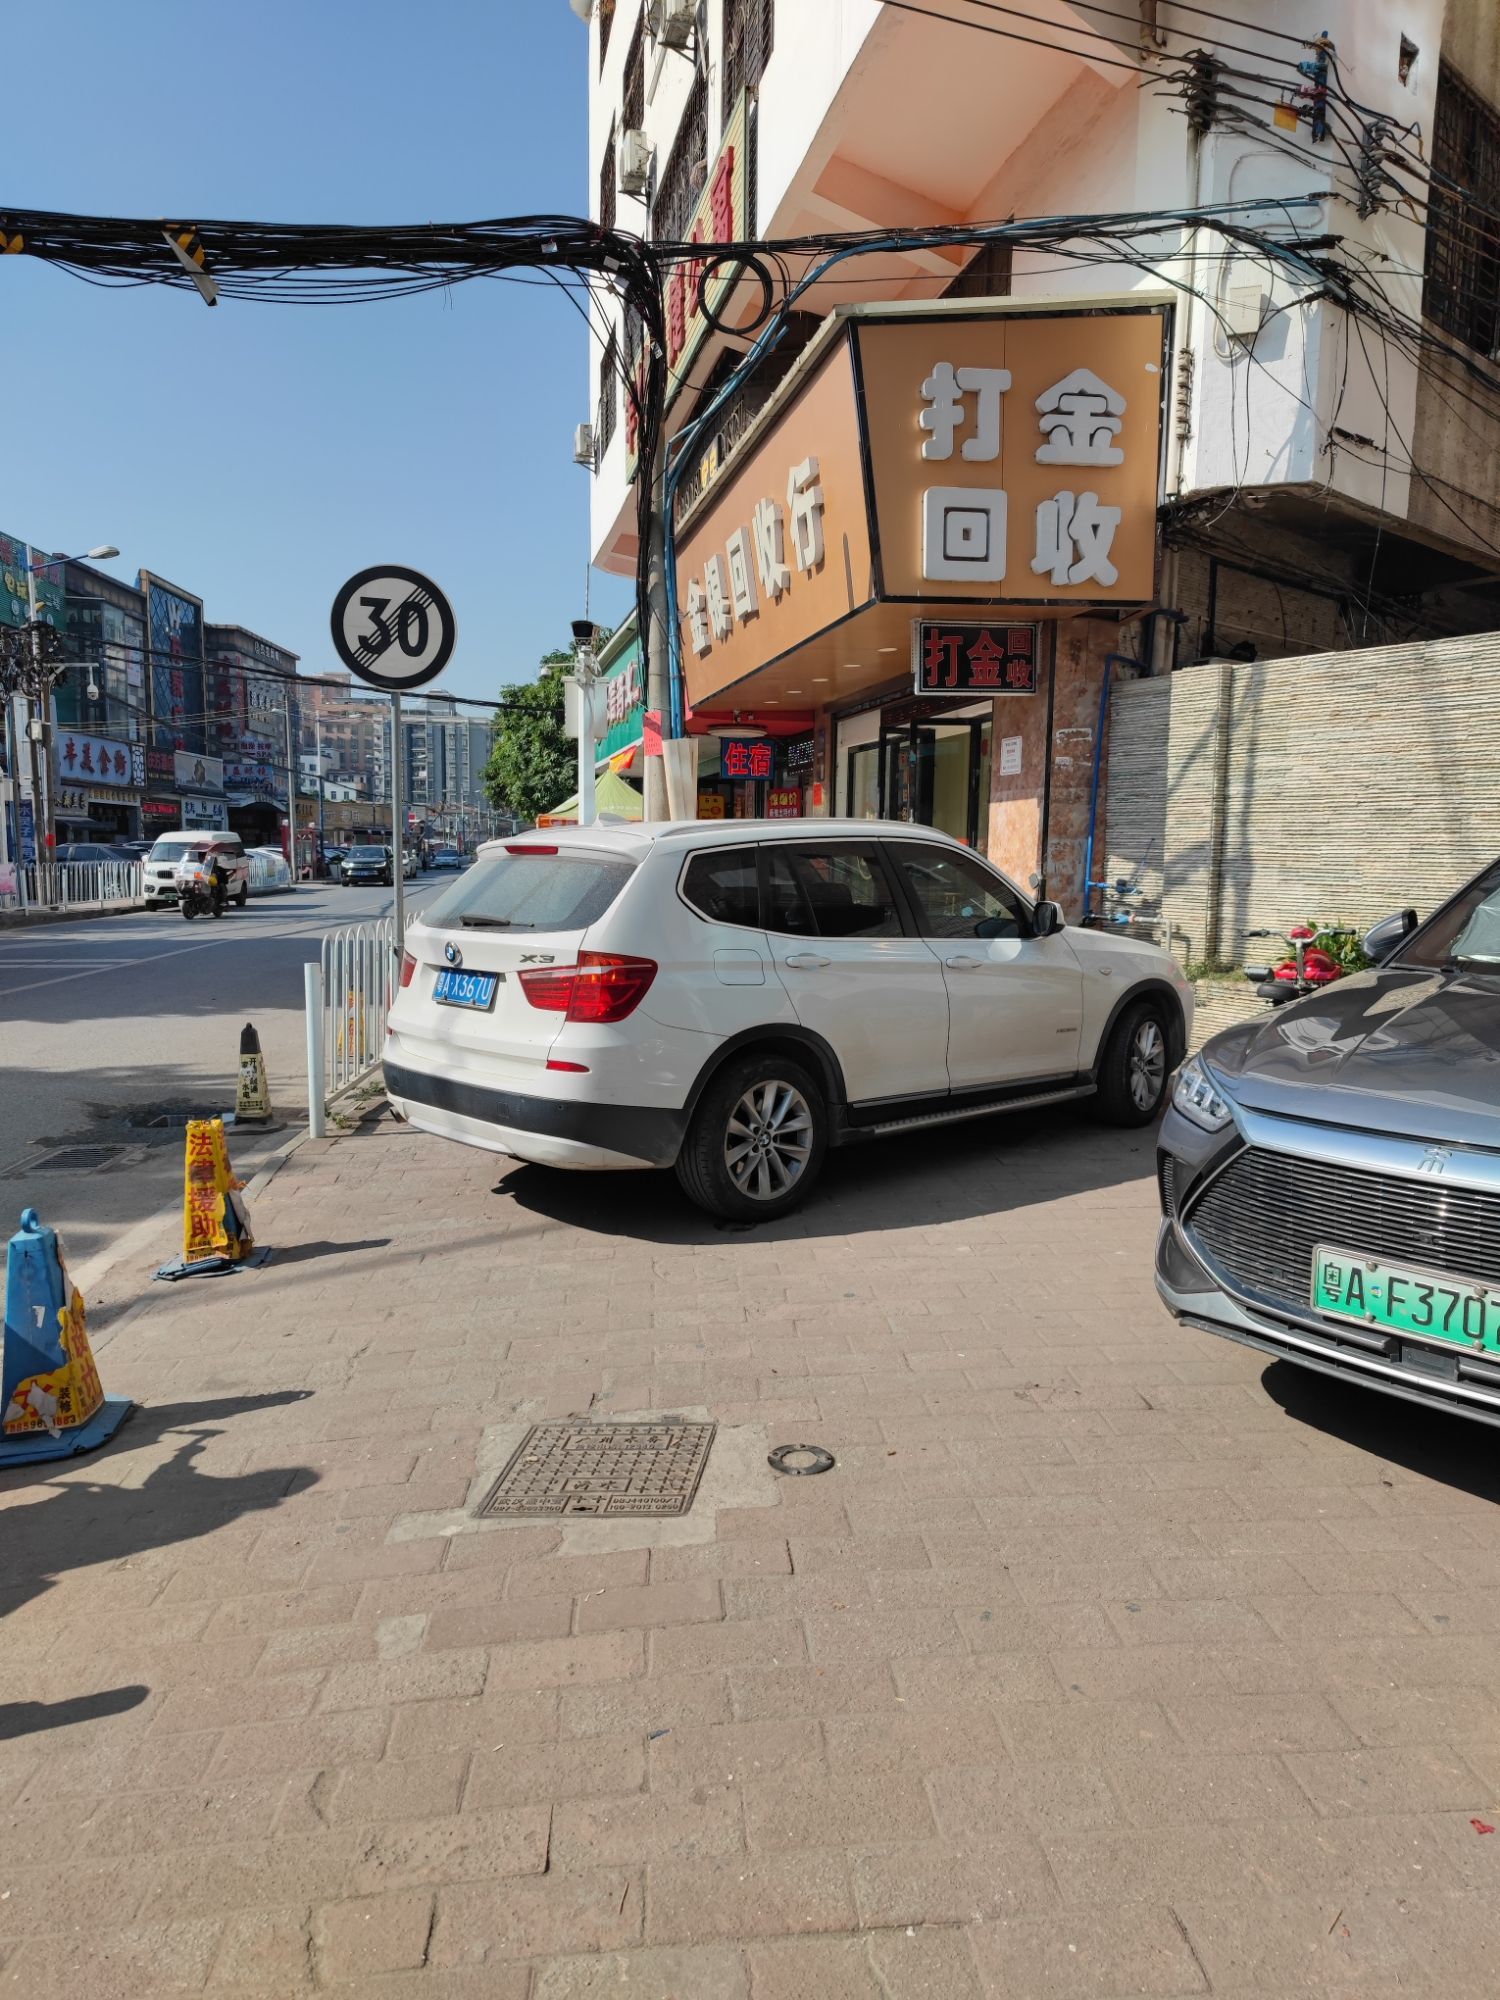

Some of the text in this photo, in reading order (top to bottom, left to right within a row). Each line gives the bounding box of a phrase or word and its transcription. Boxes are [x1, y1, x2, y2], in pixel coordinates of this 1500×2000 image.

[919, 361, 1127, 468] 打金
[685, 456, 825, 657] 金银回收行
[922, 486, 1122, 587] 回收
[357, 596, 429, 658] 30
[925, 628, 1005, 688] 打金
[1006, 628, 1033, 689] 回收
[725, 742, 772, 777] 住宿
[519, 953, 556, 964] X3
